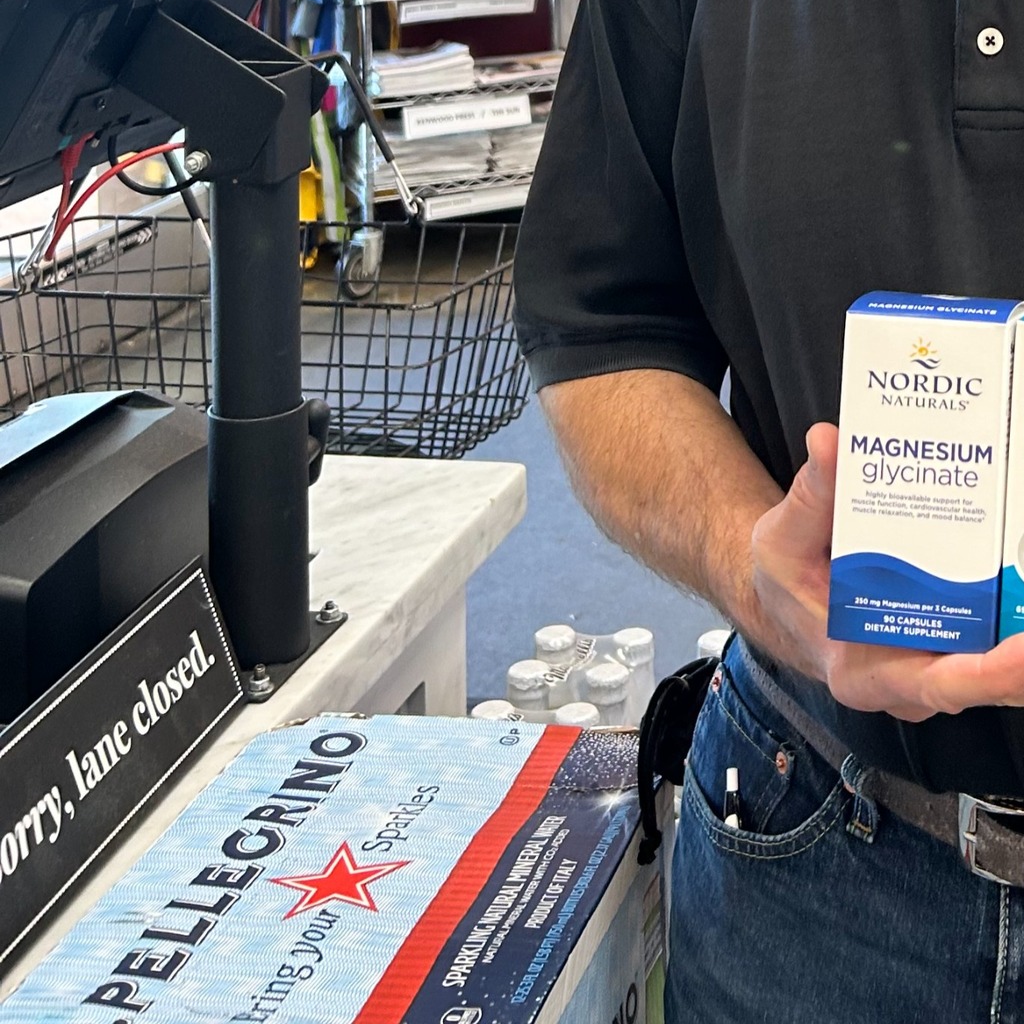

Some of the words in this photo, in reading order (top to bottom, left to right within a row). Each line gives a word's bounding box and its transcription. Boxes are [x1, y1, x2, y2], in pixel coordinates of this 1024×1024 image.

[868, 302, 934, 312] MAGNESIUM
[936, 306, 998, 316] GLYCINATE
[868, 370, 983, 397] NORDIC
[851, 434, 993, 465] MAGNESIUM
[862, 458, 979, 488] glycinate
[851, 498, 876, 507] muscle
[877, 500, 908, 510] function,
[910, 503, 961, 513] cardiovascular
[962, 505, 987, 516] health,
[865, 490, 887, 500] highly
[889, 492, 931, 503] bioavailable
[933, 496, 961, 506] support
[962, 498, 973, 506] for
[852, 506, 877, 514] muscle
[878, 508, 915, 518] relaxation,
[917, 512, 930, 520] and
[932, 513, 953, 521] mood
[855, 597, 869, 605] 250
[869, 600, 881, 608] mg
[882, 599, 921, 610] Magnesium
[922, 604, 934, 613] per
[935, 604, 940, 612] 3
[941, 605, 972, 615] Capsules
[864, 623, 902, 634] DIETARY
[903, 627, 961, 640] SUPPLEMENT
[883, 614, 895, 624] 90
[897, 616, 942, 628] CAPSULES
[0, 786, 75, 881] orry,
[65, 718, 132, 801] lane
[131, 631, 217, 735] closed.
[290, 908, 343, 963] your
[362, 785, 441, 853] Sparkles
[552, 858, 578, 882] ITALY
[546, 883, 565, 894] OF
[442, 925, 496, 988] SPARKLING
[478, 882, 525, 924] NATURAL
[506, 838, 549, 882] MINERAL
[531, 816, 568, 838] WATER
[482, 929, 510, 964] NATURAL
[520, 880, 540, 903] WATER
[532, 861, 550, 881] WITH
[524, 894, 559, 929] PRODUCT
